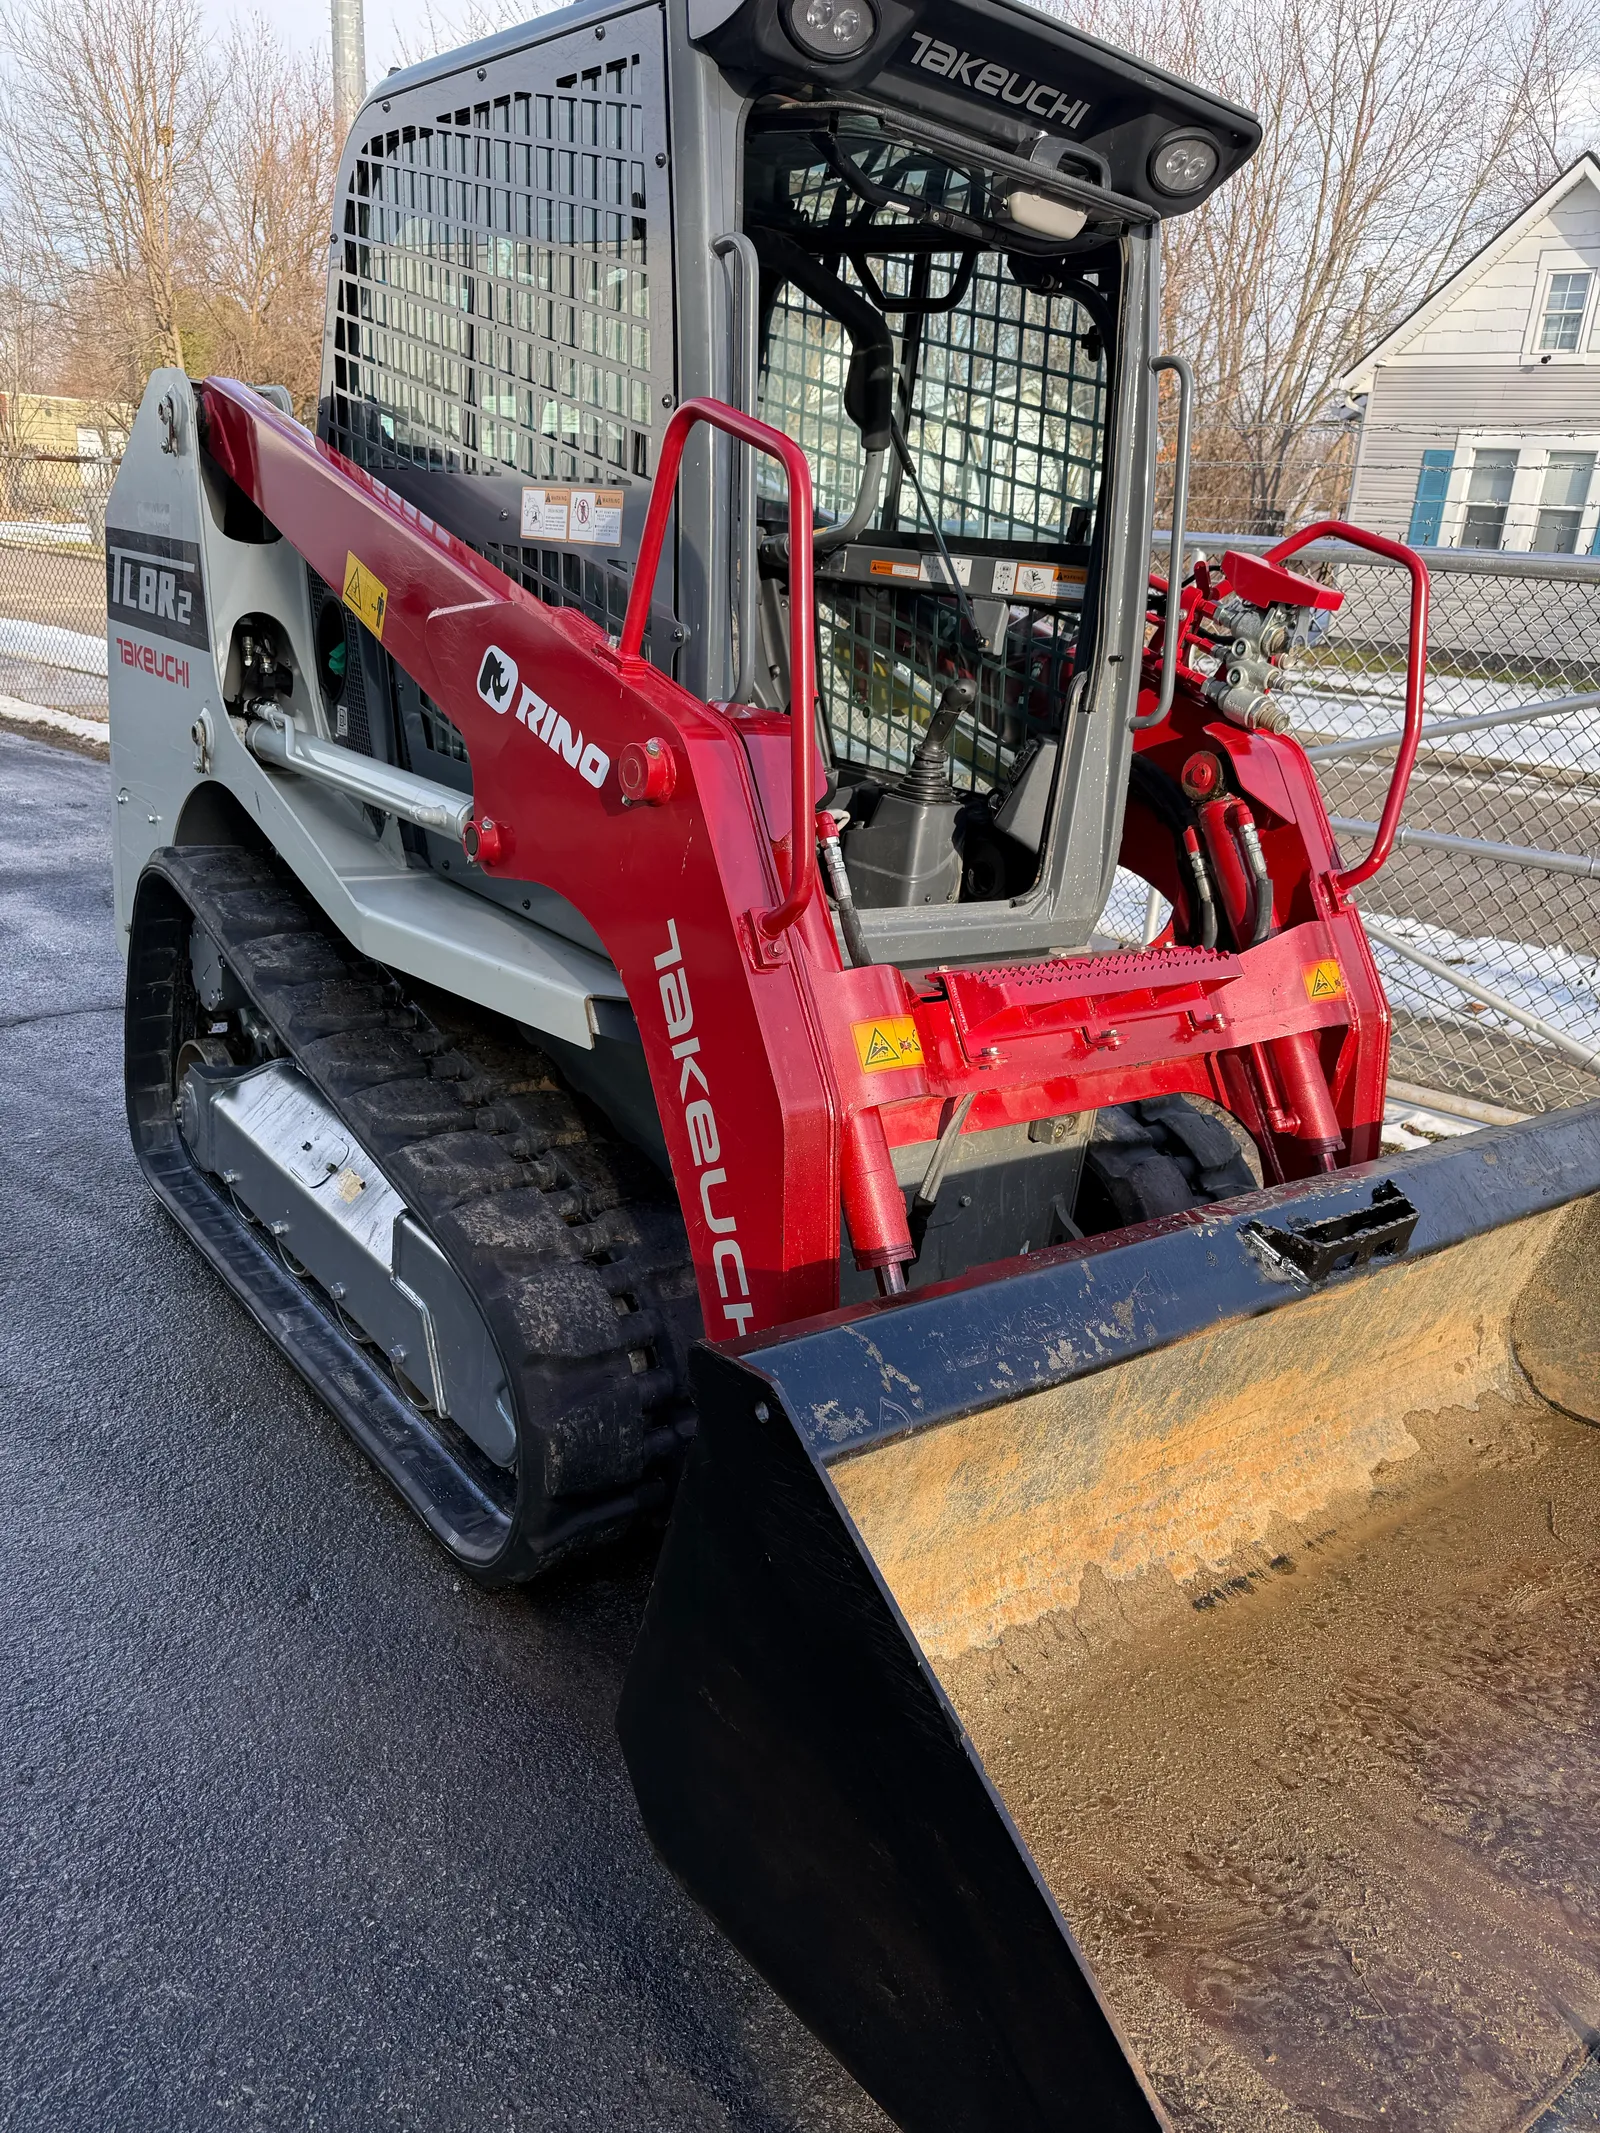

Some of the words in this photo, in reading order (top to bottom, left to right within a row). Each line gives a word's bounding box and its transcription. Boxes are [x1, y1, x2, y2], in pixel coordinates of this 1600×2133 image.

[910, 31, 1091, 130] TAKEUCHI
[116, 637, 190, 690] TAKEUCHI
[515, 681, 610, 789] RINO
[653, 917, 755, 1337] TAKEUCH
